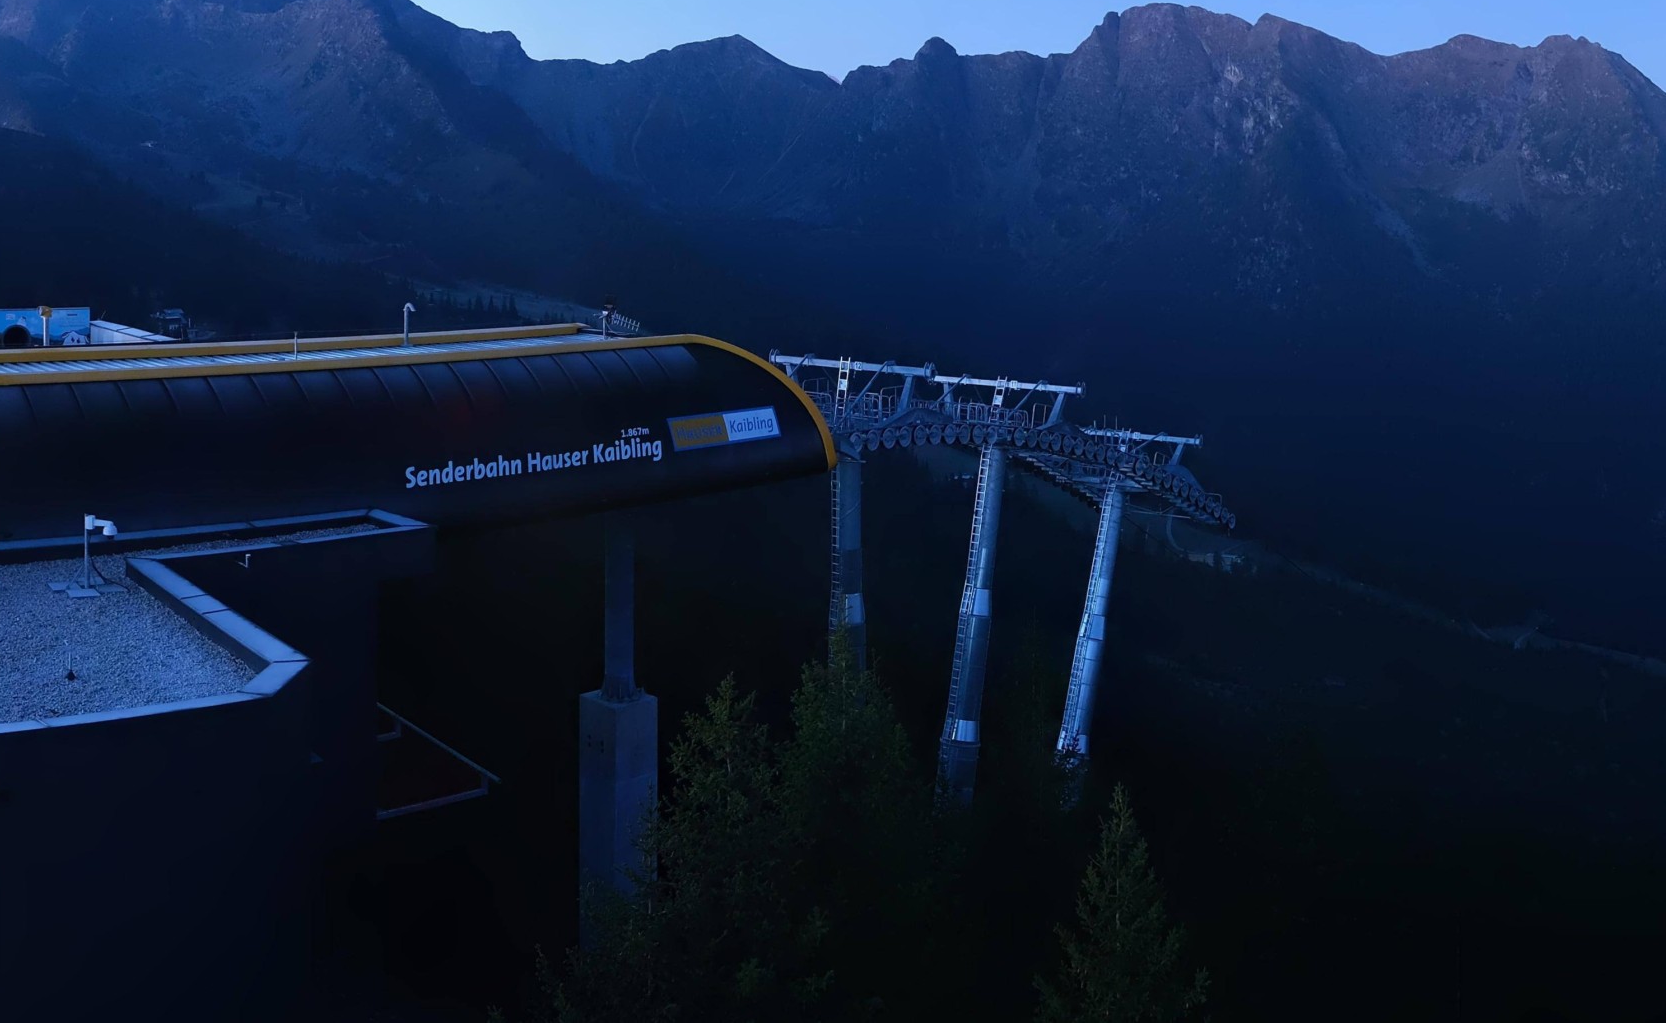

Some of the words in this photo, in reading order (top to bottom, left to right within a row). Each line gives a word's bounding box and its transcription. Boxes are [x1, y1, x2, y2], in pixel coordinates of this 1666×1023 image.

[620, 427, 650, 438] 1.867m
[729, 416, 774, 434] Kaibling
[404, 454, 522, 489] Senderbahn
[527, 446, 589, 474] Hauser
[592, 438, 662, 463] Kaibling
